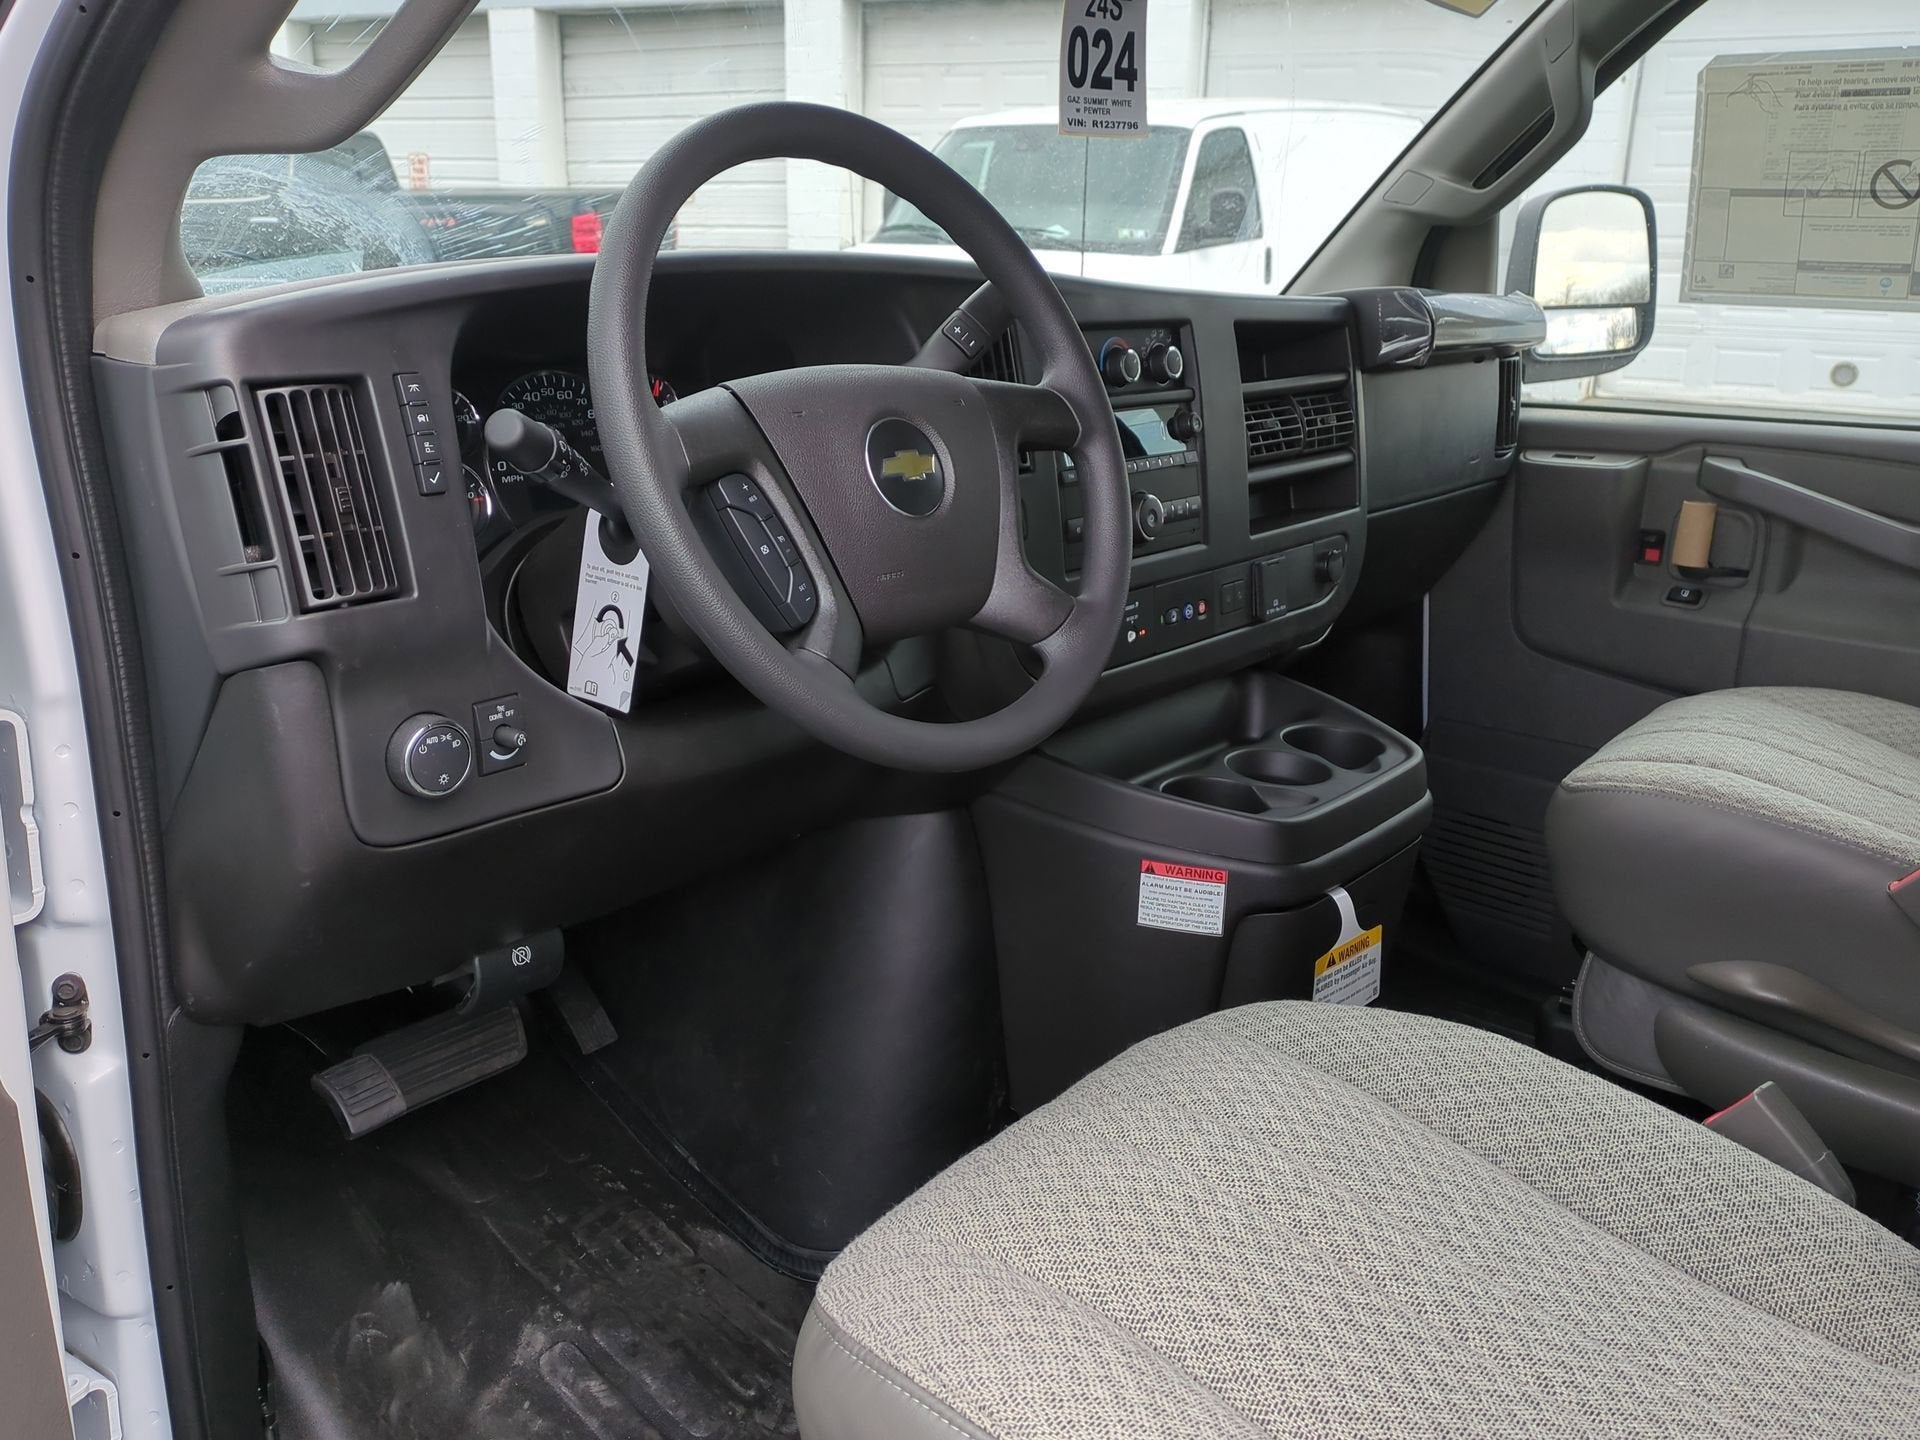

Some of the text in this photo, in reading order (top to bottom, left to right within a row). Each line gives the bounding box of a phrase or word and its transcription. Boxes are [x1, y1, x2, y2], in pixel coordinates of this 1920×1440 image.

[1068, 25, 1138, 92] 024
[1084, 97, 1108, 106] SUMMIT
[1111, 99, 1132, 108] WHITE
[1084, 107, 1110, 115] PEWTER
[1067, 118, 1138, 130] VIN: R1237796
[523, 392, 540, 401] 40
[557, 391, 573, 400] 60
[498, 461, 506, 471] 0
[798, 583, 807, 592] SET
[1165, 865, 1223, 880] WARNING
[1194, 888, 1223, 896] AUDIBLE!
[1338, 936, 1370, 962] WARNING
